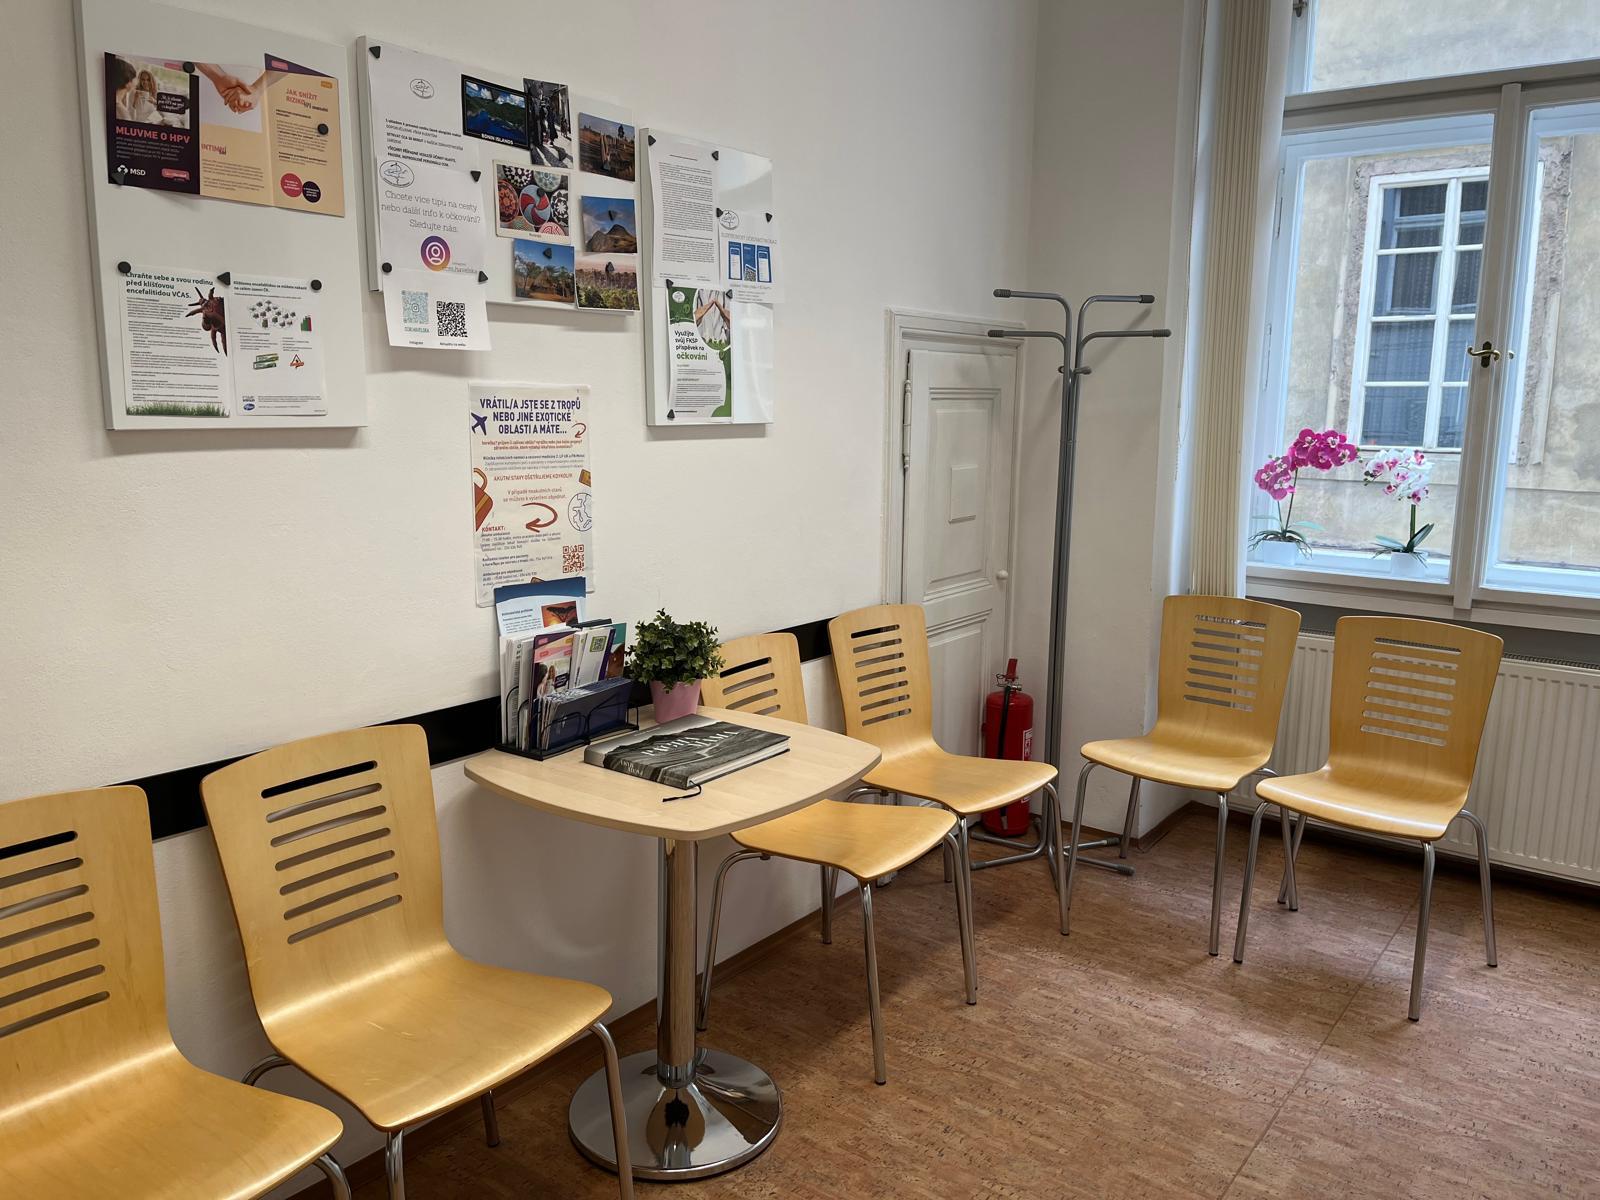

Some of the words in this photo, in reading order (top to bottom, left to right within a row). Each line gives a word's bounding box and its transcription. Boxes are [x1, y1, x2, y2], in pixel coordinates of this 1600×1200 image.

[116, 126, 158, 140] MLUVME
[161, 132, 168, 140] O
[170, 133, 190, 144] HPV
[130, 168, 146, 176] MSD
[385, 190, 412, 202] Chcete
[414, 196, 430, 204] více
[459, 202, 477, 213] cesty
[381, 204, 400, 212] nebo
[402, 206, 420, 215] další
[422, 208, 437, 217] info
[440, 211, 443, 219] k
[445, 213, 480, 224] očkování?
[409, 219, 441, 231] Sledujte
[126, 271, 152, 280] Chraňte
[192, 278, 213, 286] rodinu
[127, 288, 170, 297] encefalitidou
[172, 290, 191, 298] VČAS.
[677, 352, 708, 360] očkování
[480, 396, 518, 410] VRÁTIL/A
[520, 400, 538, 409] JSTE
[540, 400, 549, 409] SE
[551, 400, 555, 409] Z
[557, 397, 580, 410] TROPŮ
[493, 412, 515, 421] NEBO
[517, 410, 534, 421] JINÉ
[536, 410, 571, 421] EXOTICKÉ
[498, 424, 531, 434] OBLASTI
[533, 424, 538, 434] A
[540, 422, 567, 434] MÁTE...
